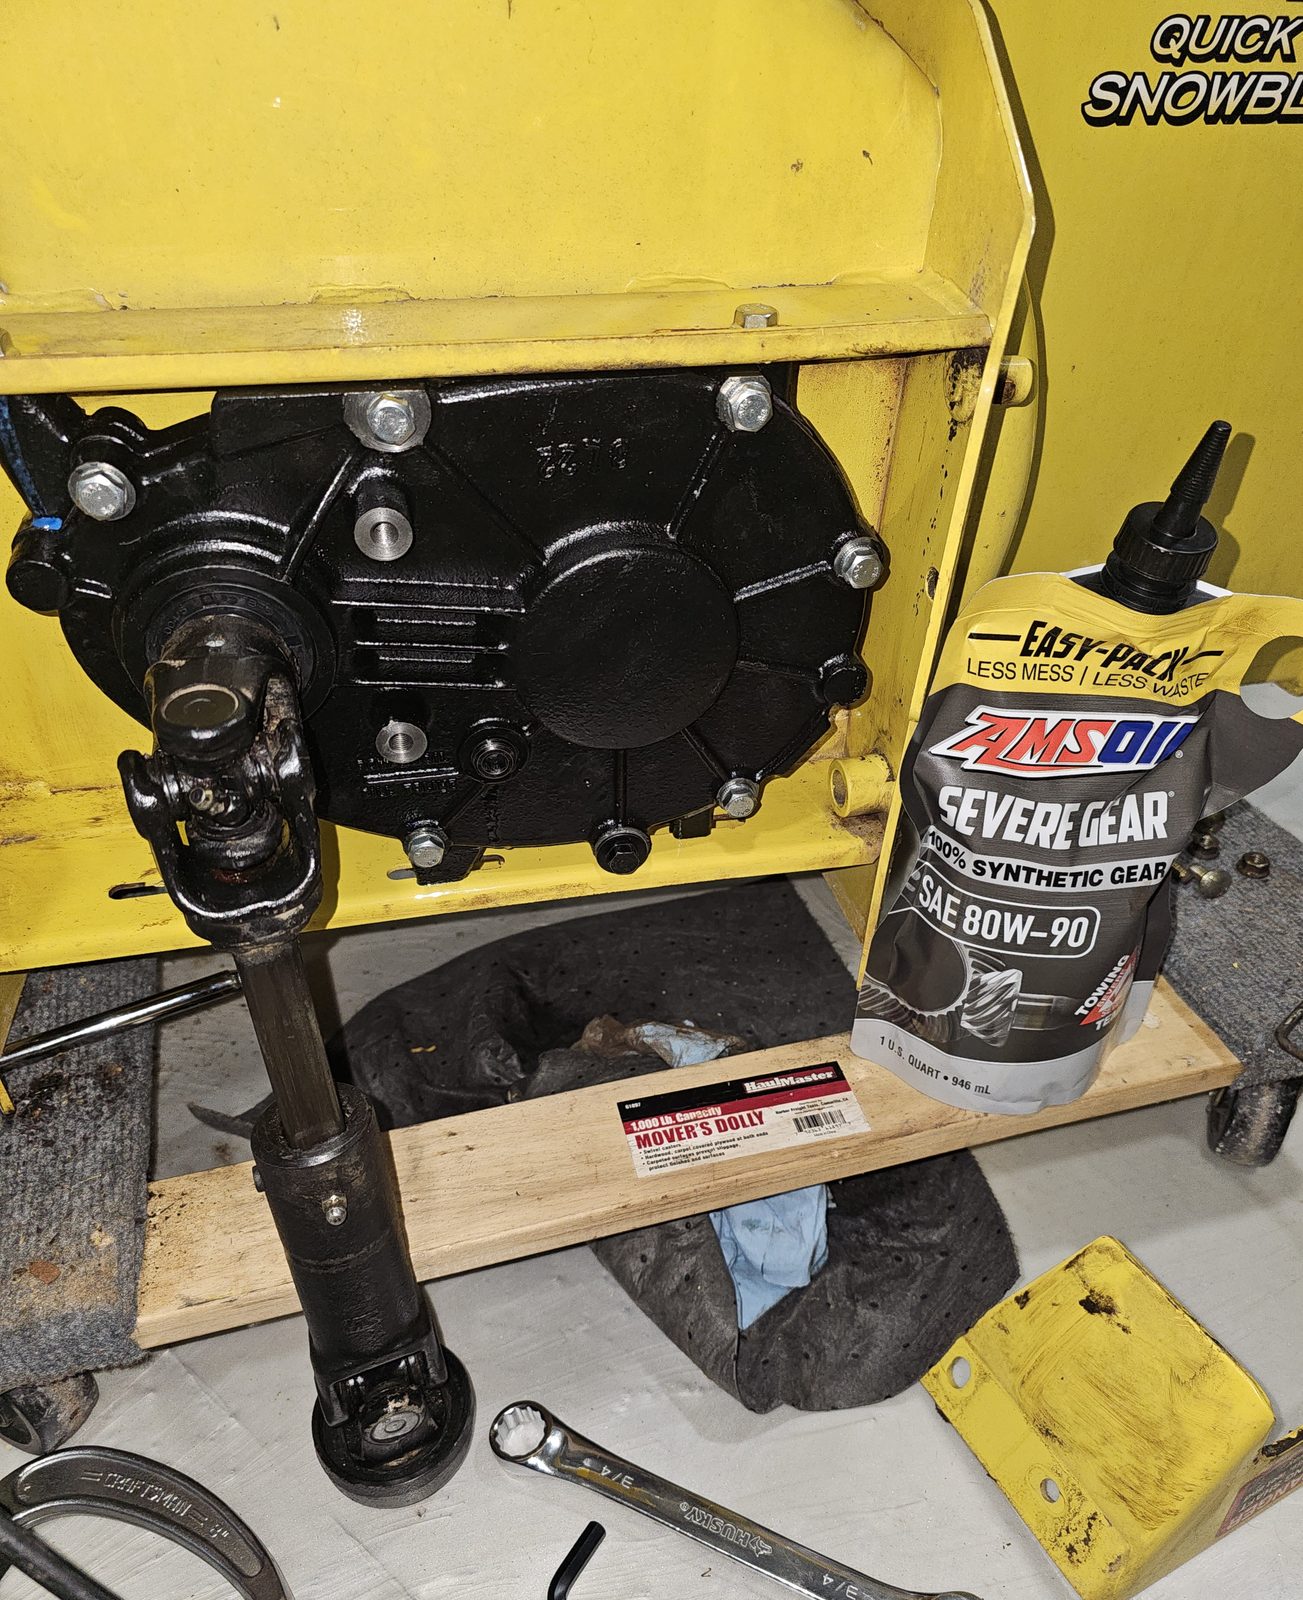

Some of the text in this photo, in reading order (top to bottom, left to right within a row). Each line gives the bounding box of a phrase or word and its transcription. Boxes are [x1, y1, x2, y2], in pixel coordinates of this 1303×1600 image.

[1150, 14, 1303, 67] QUICK
[1019, 620, 1190, 682] EASY-PACK
[967, 657, 1017, 680] LESS
[1022, 662, 1074, 682] MESS
[1092, 671, 1148, 689] LESS
[1152, 672, 1210, 698] WASTE
[938, 786, 1168, 850] SEVERE GEAR
[928, 830, 1168, 888] 100% SYNTHETIC GEAR
[919, 874, 1090, 948] SAE 80W-90
[1074, 954, 1130, 1016] TOWING
[743, 1071, 833, 1093] HaulMaster
[880, 1036, 991, 1095] 1 U.S. QUART 946 mL
[630, 1106, 722, 1132] 1,000 Lb. Capacity
[634, 1110, 765, 1149] MOVER'S DOLLY
[104, 1472, 192, 1517] CRAFTSMAN
[600, 1464, 634, 1489] 3/4
[685, 1506, 750, 1547] HUSKY
[823, 1573, 858, 1600] 3/4
